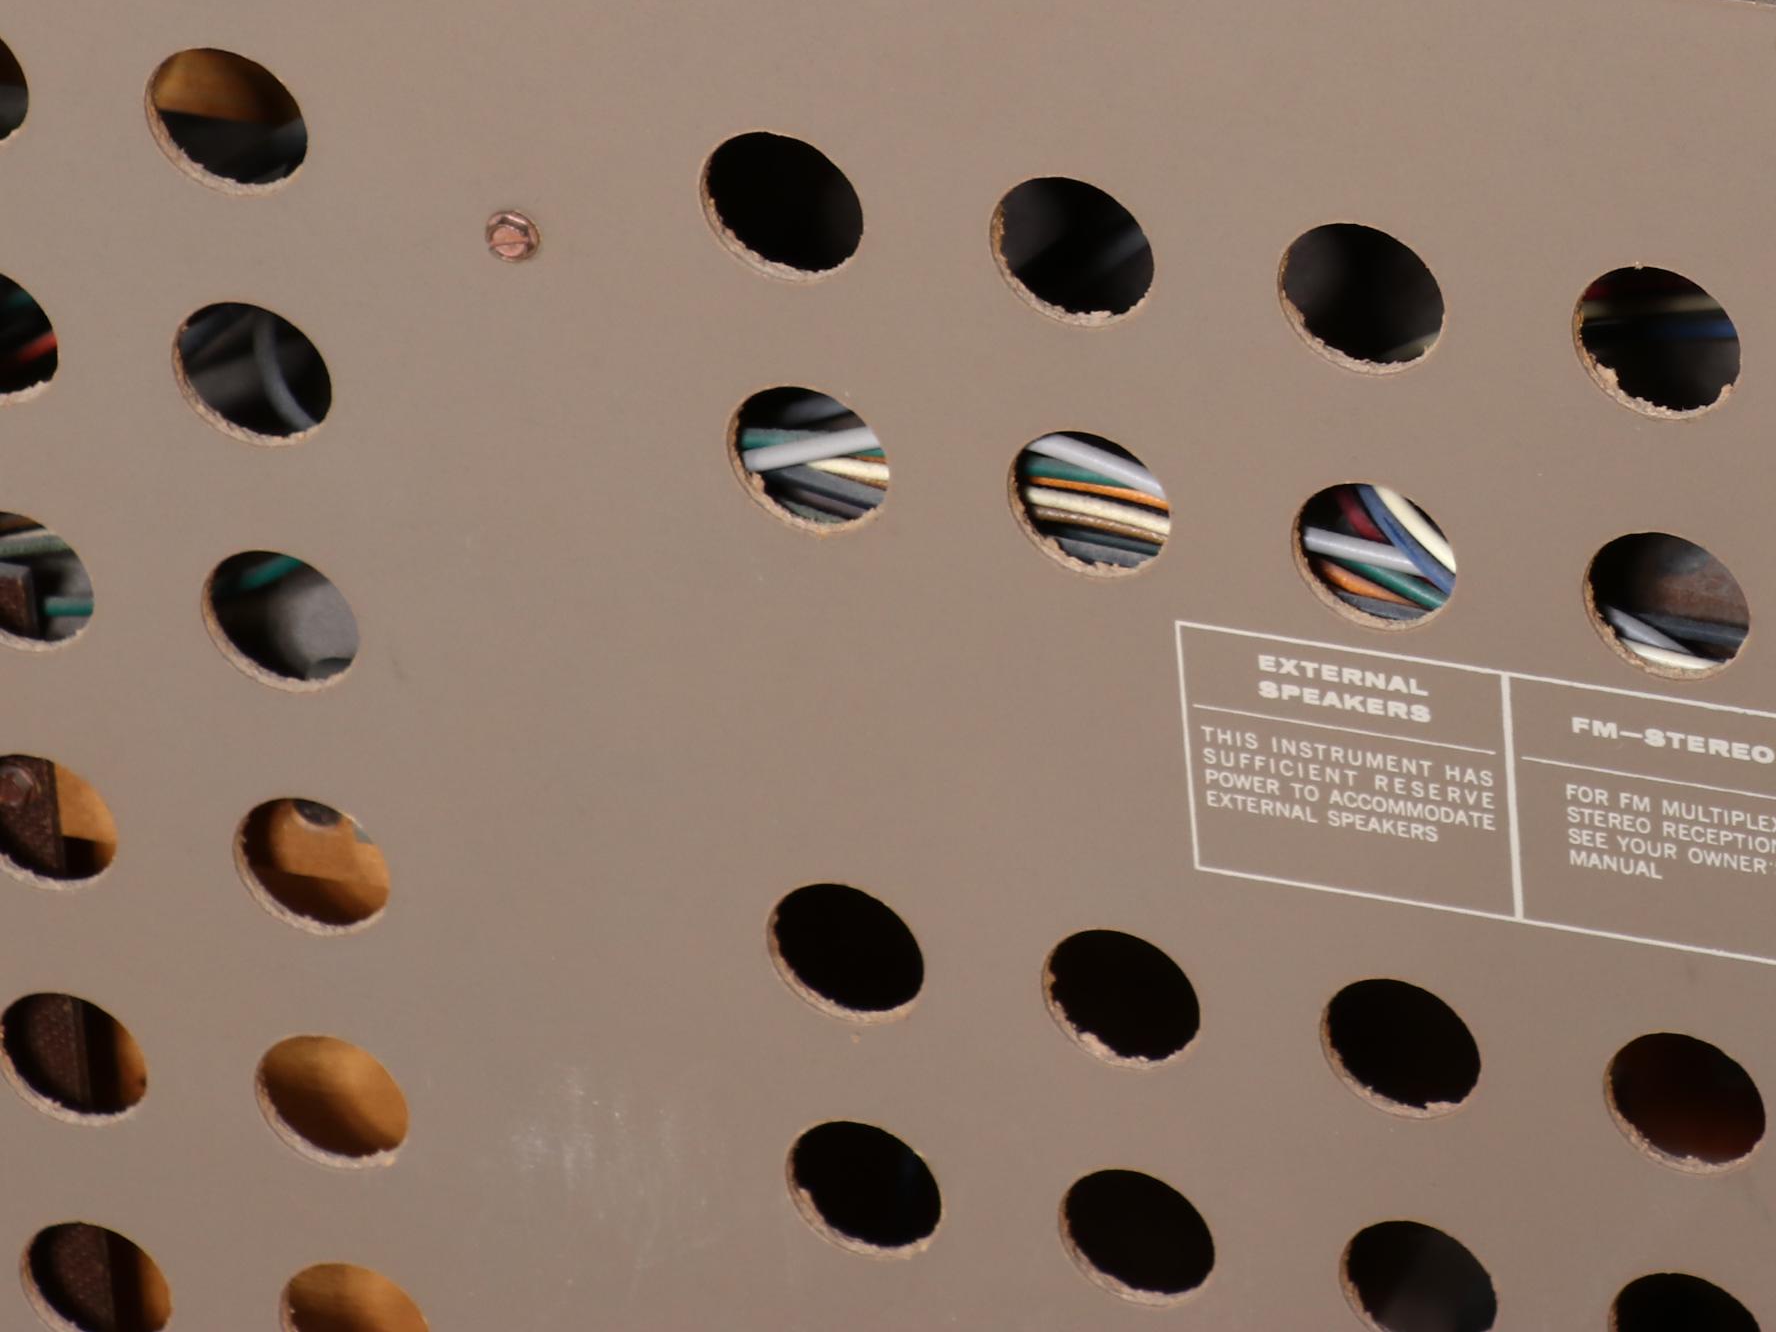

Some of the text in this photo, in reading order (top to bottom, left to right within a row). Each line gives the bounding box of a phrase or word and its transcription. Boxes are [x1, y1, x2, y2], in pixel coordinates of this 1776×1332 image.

[1258, 654, 1428, 696] EXTERNAL
[1258, 680, 1430, 722] SPEAKERS
[1200, 725, 1492, 786] THIS INSTRUMENT HAS
[1202, 747, 1494, 808] SUFFICIENT RESERVE
[1566, 783, 1608, 805] FOR
[1619, 792, 1650, 812] FM
[1204, 768, 1495, 830] POWER TO ACCOMMODATE
[1206, 790, 1438, 841] EXTERNAL SPEAKERS
[1567, 806, 1651, 833] STEREO
[1568, 827, 1608, 848] SEE
[1616, 835, 1676, 858] YOUR
[1569, 849, 1662, 879] MANUAL
